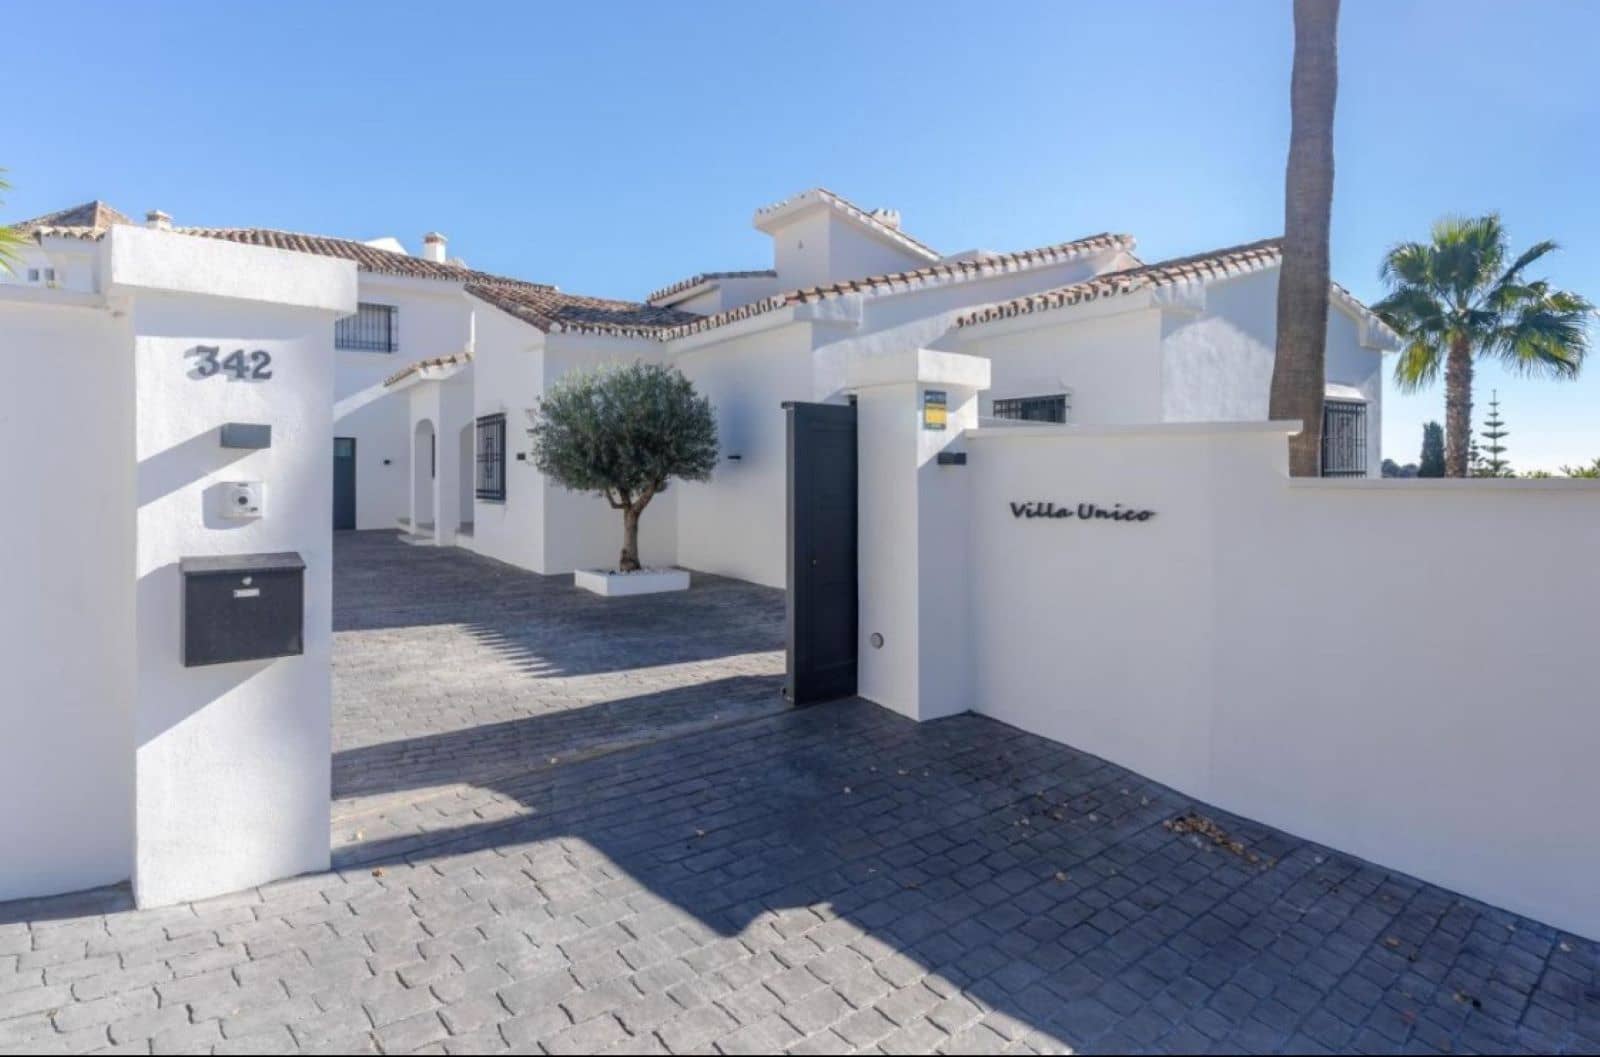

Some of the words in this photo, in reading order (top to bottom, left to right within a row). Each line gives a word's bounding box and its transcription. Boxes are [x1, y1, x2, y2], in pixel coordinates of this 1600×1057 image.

[196, 345, 272, 379] 342
[1010, 502, 1073, 518] Villa
[1078, 503, 1155, 521] Unico
